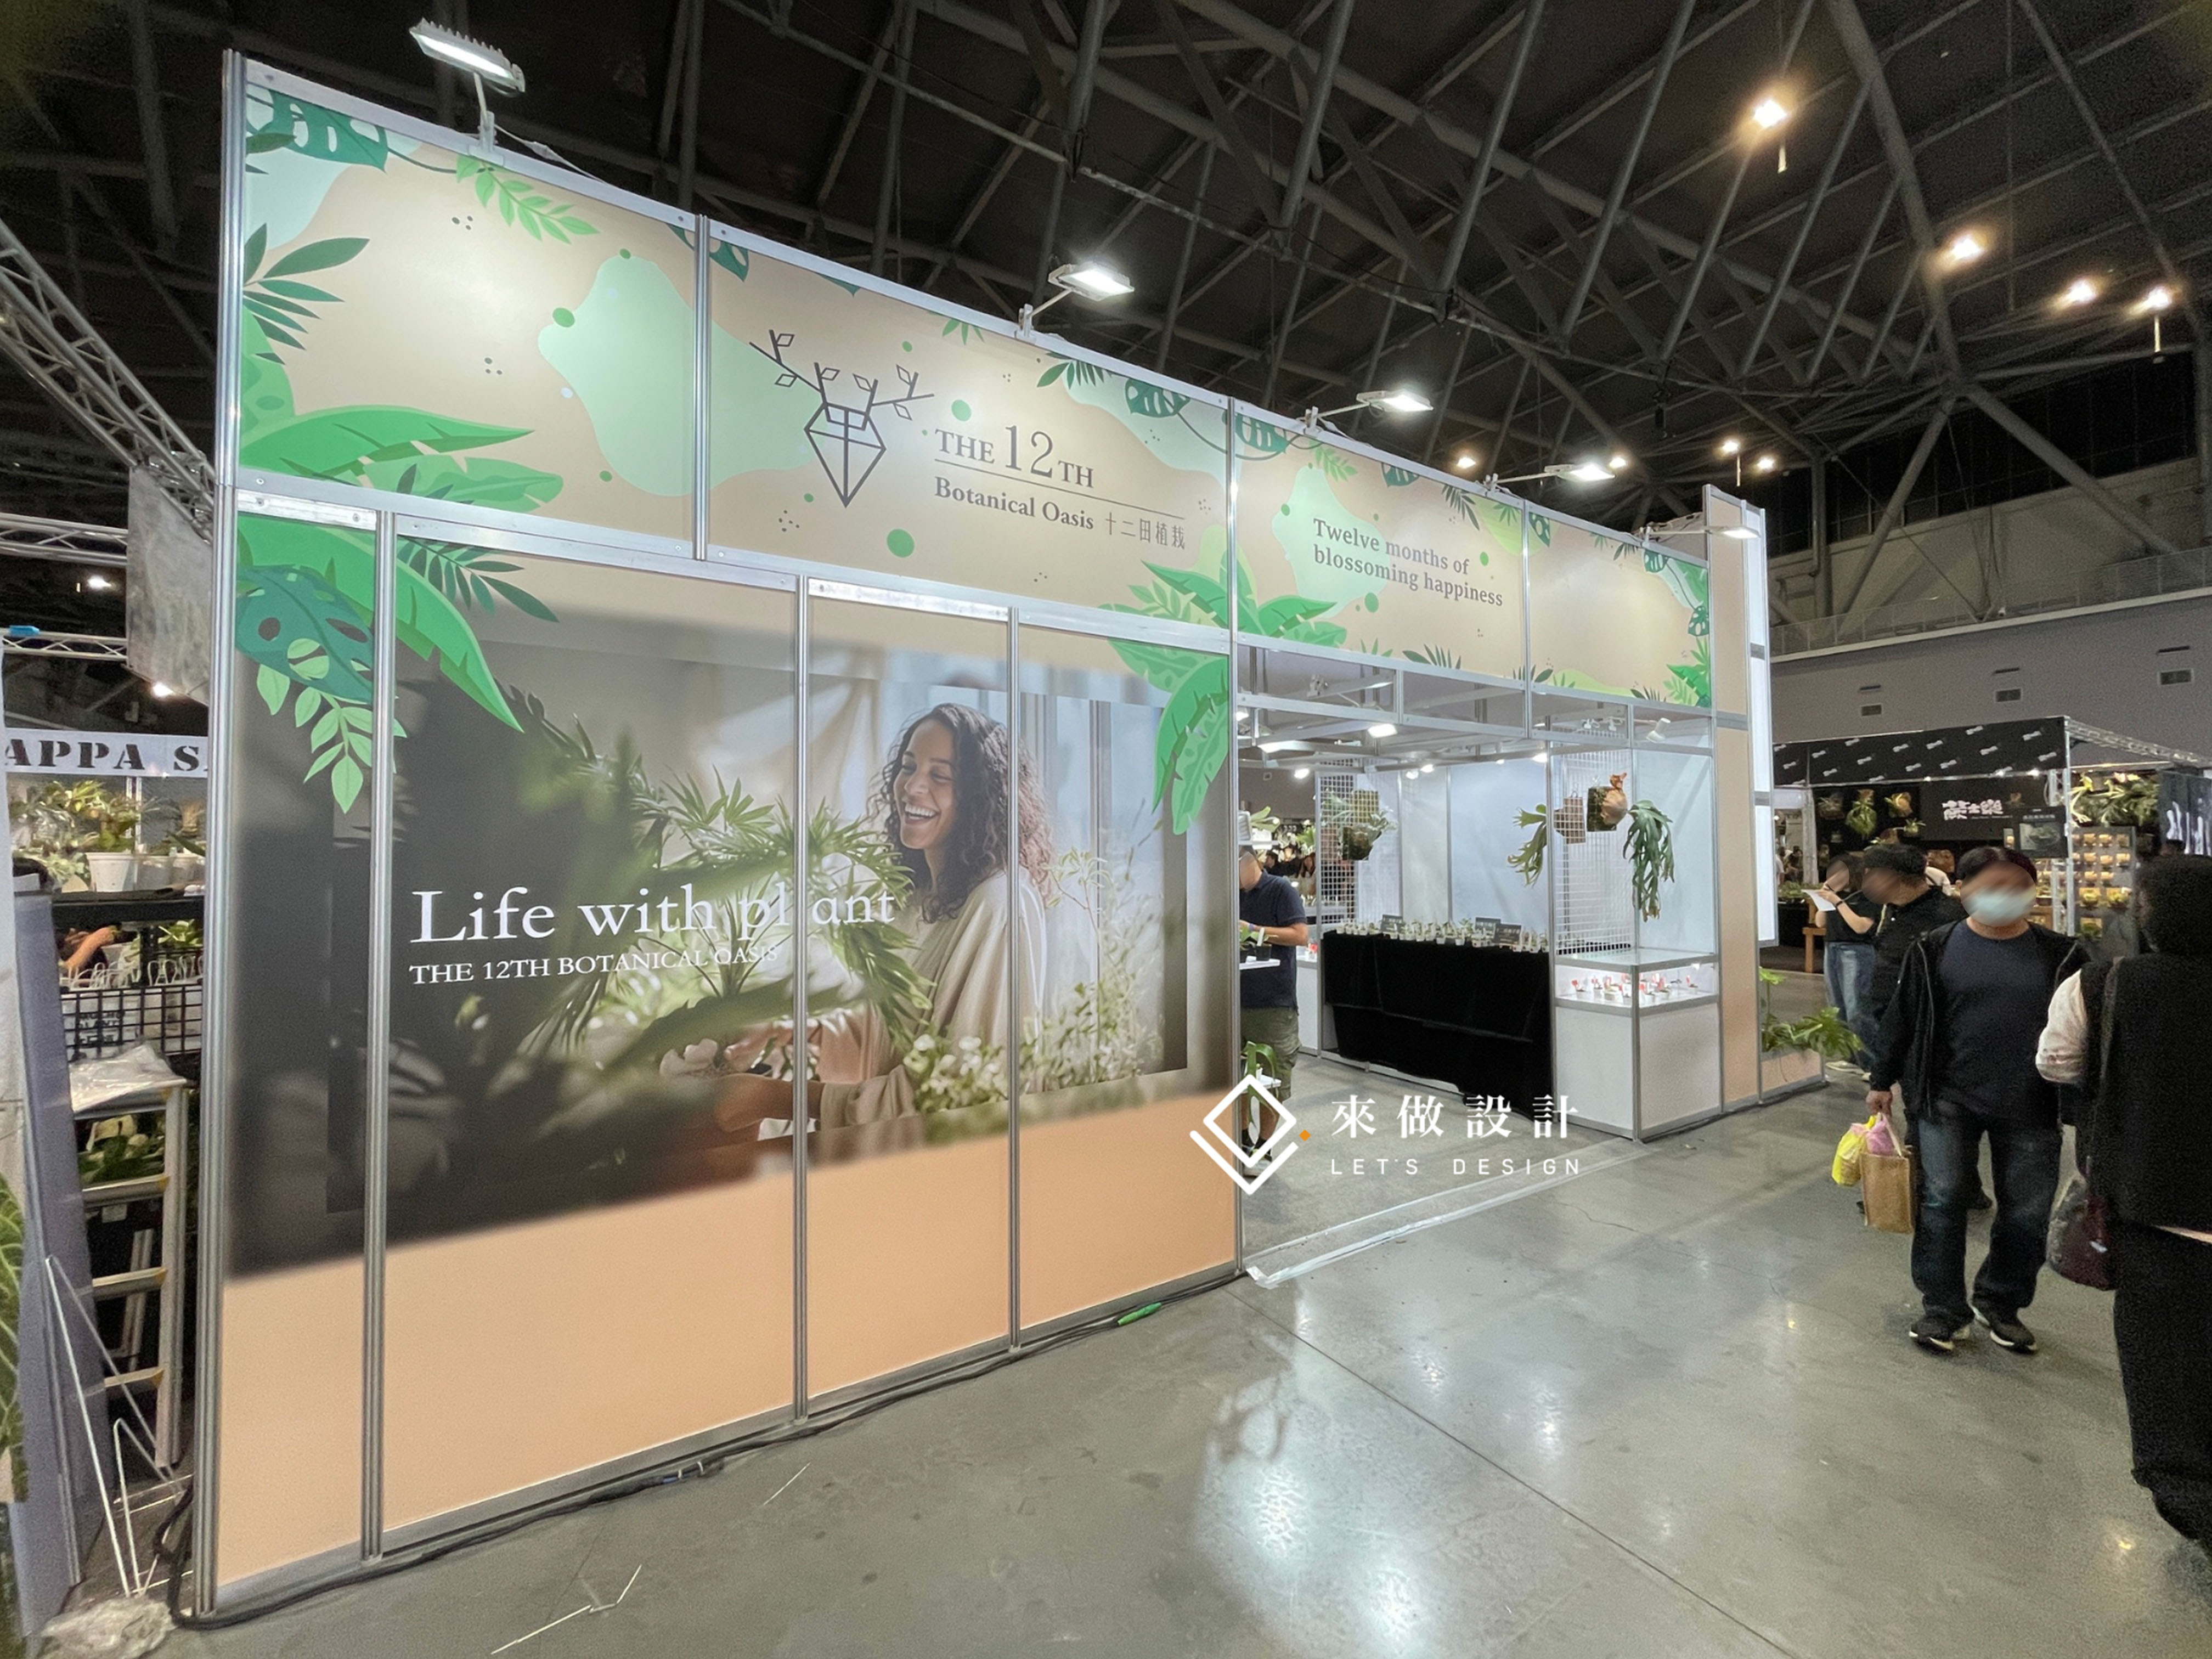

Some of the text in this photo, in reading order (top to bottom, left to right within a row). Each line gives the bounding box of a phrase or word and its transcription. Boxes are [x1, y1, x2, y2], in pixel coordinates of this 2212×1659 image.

[934, 426, 1094, 488] THE 12TH
[934, 476, 1094, 531] Botanical Oasis
[1105, 512, 1186, 550] 十二田植栽
[1313, 518, 1470, 574] Twelve months of
[1314, 544, 1503, 607] blossoming happiness
[410, 887, 555, 943] Life
[578, 883, 714, 936] with
[409, 944, 778, 985] THE 12TH BOTANICAL OASIS
